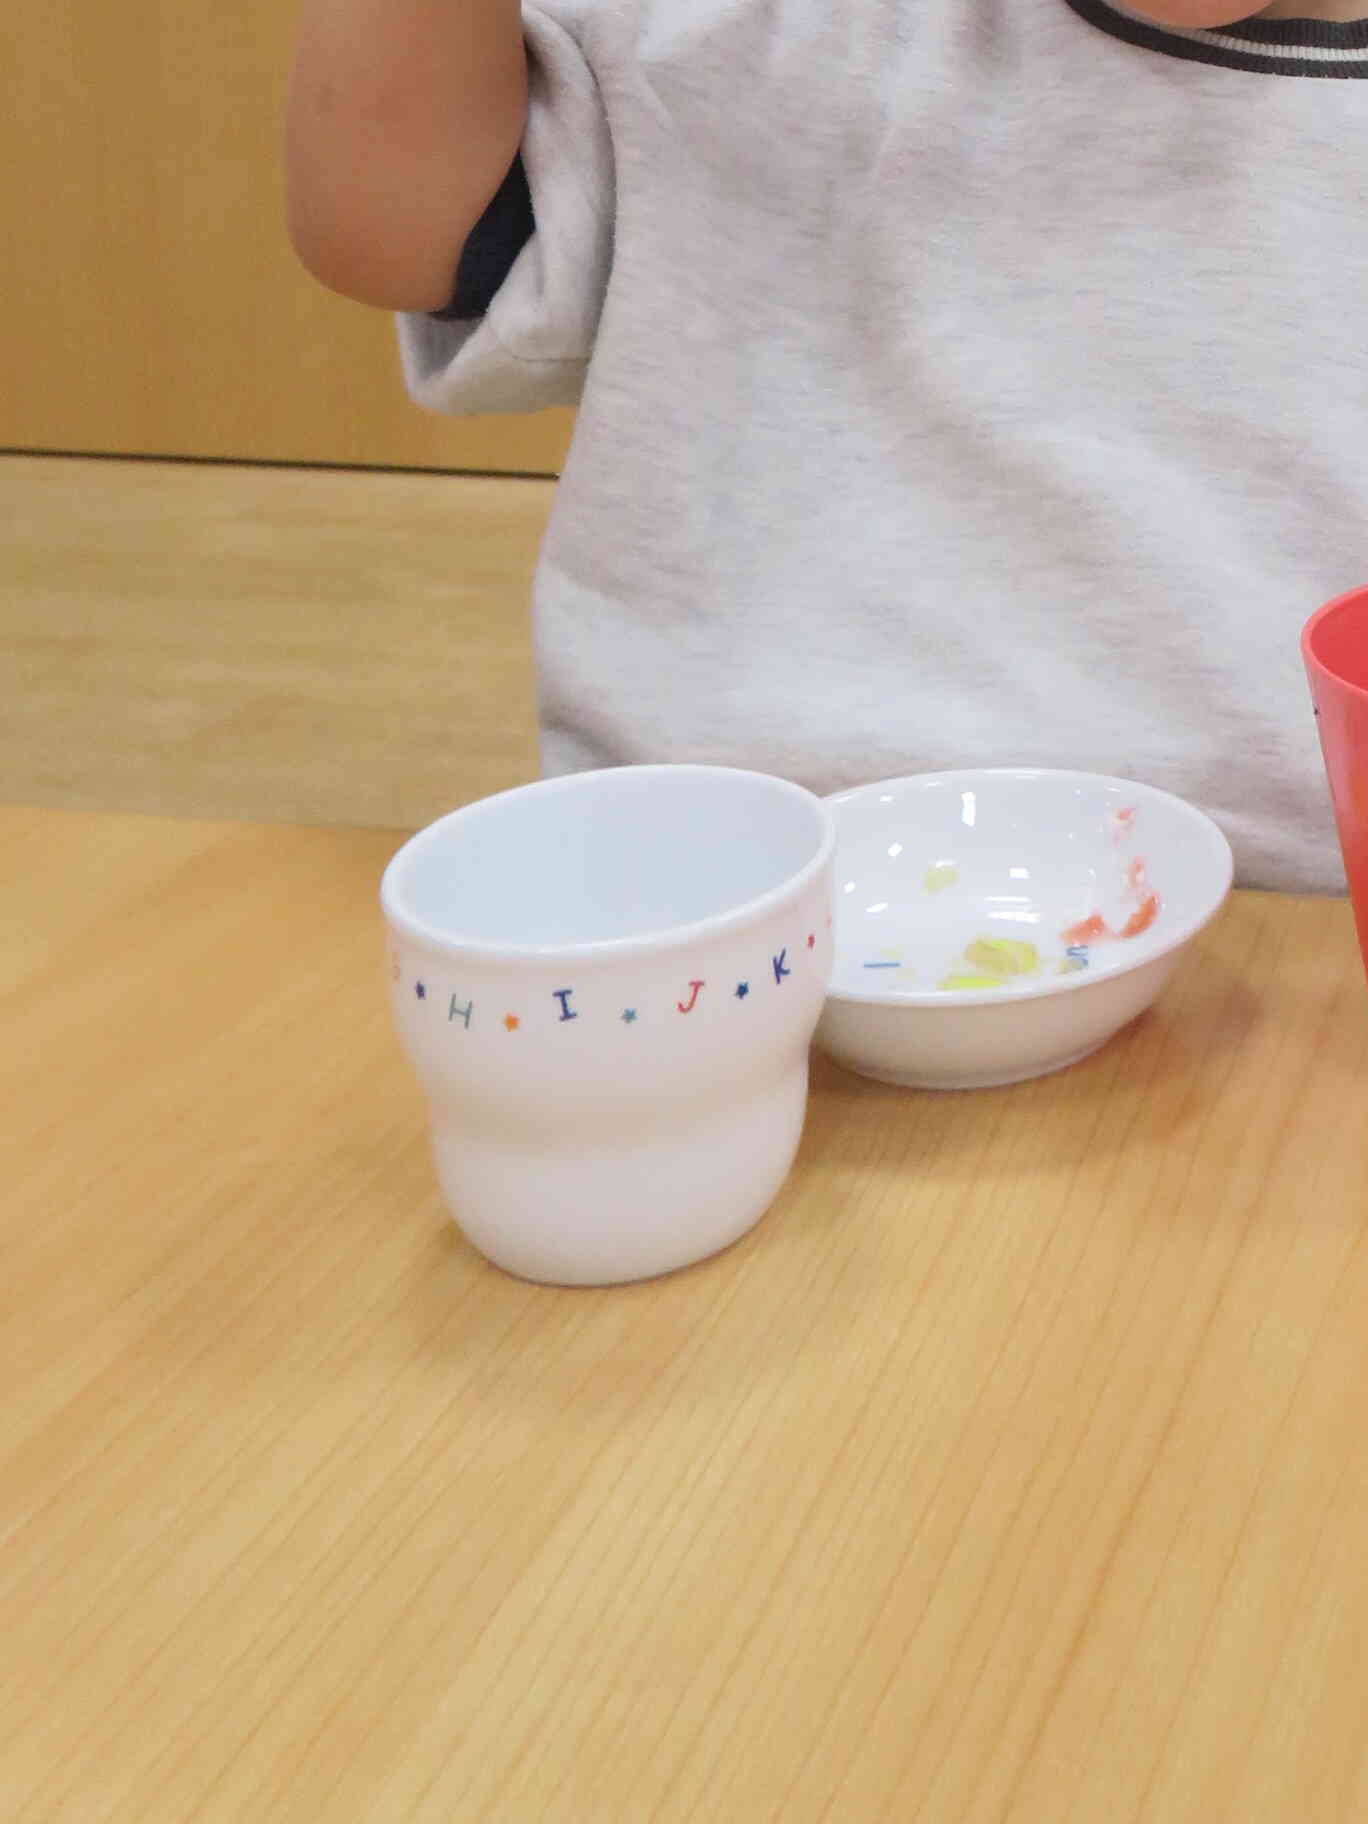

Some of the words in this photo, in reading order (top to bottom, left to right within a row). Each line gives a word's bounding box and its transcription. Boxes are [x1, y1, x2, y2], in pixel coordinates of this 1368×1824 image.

[448, 992, 474, 1030] H
[551, 988, 578, 1022] I
[677, 980, 705, 1014] J
[772, 948, 791, 985] K
